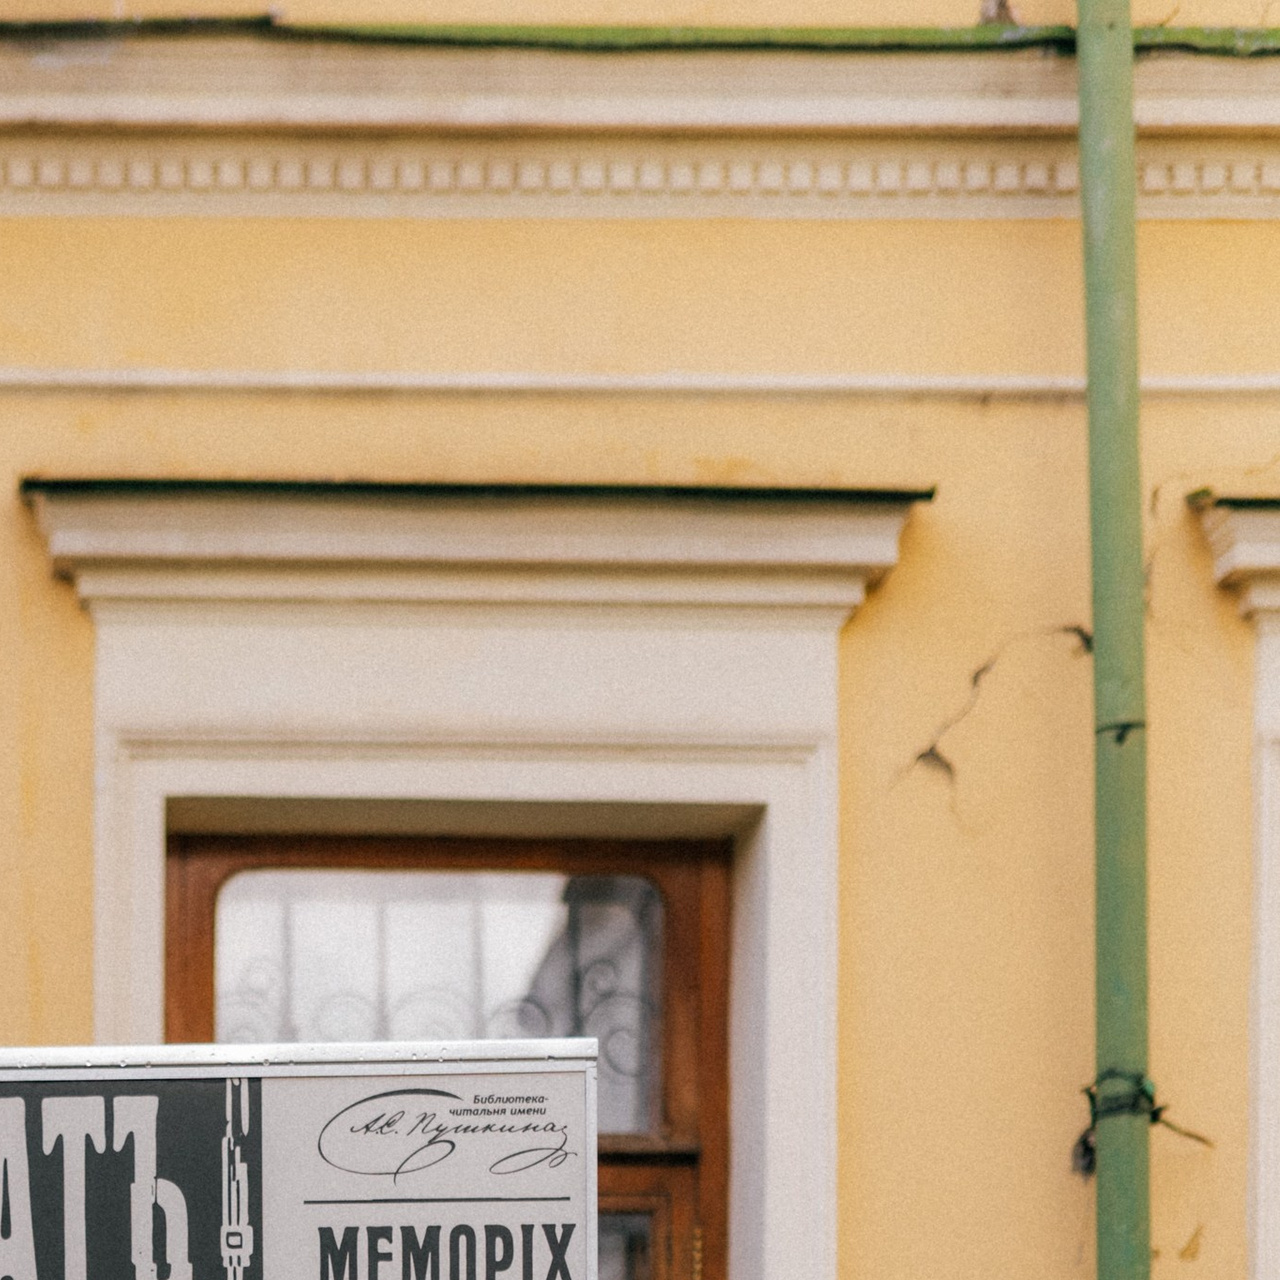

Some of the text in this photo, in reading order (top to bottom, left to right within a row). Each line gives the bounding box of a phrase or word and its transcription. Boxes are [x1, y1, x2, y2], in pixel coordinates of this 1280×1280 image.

[473, 1094, 549, 1105] Библиотека-
[449, 1106, 547, 1117] читальня имени
